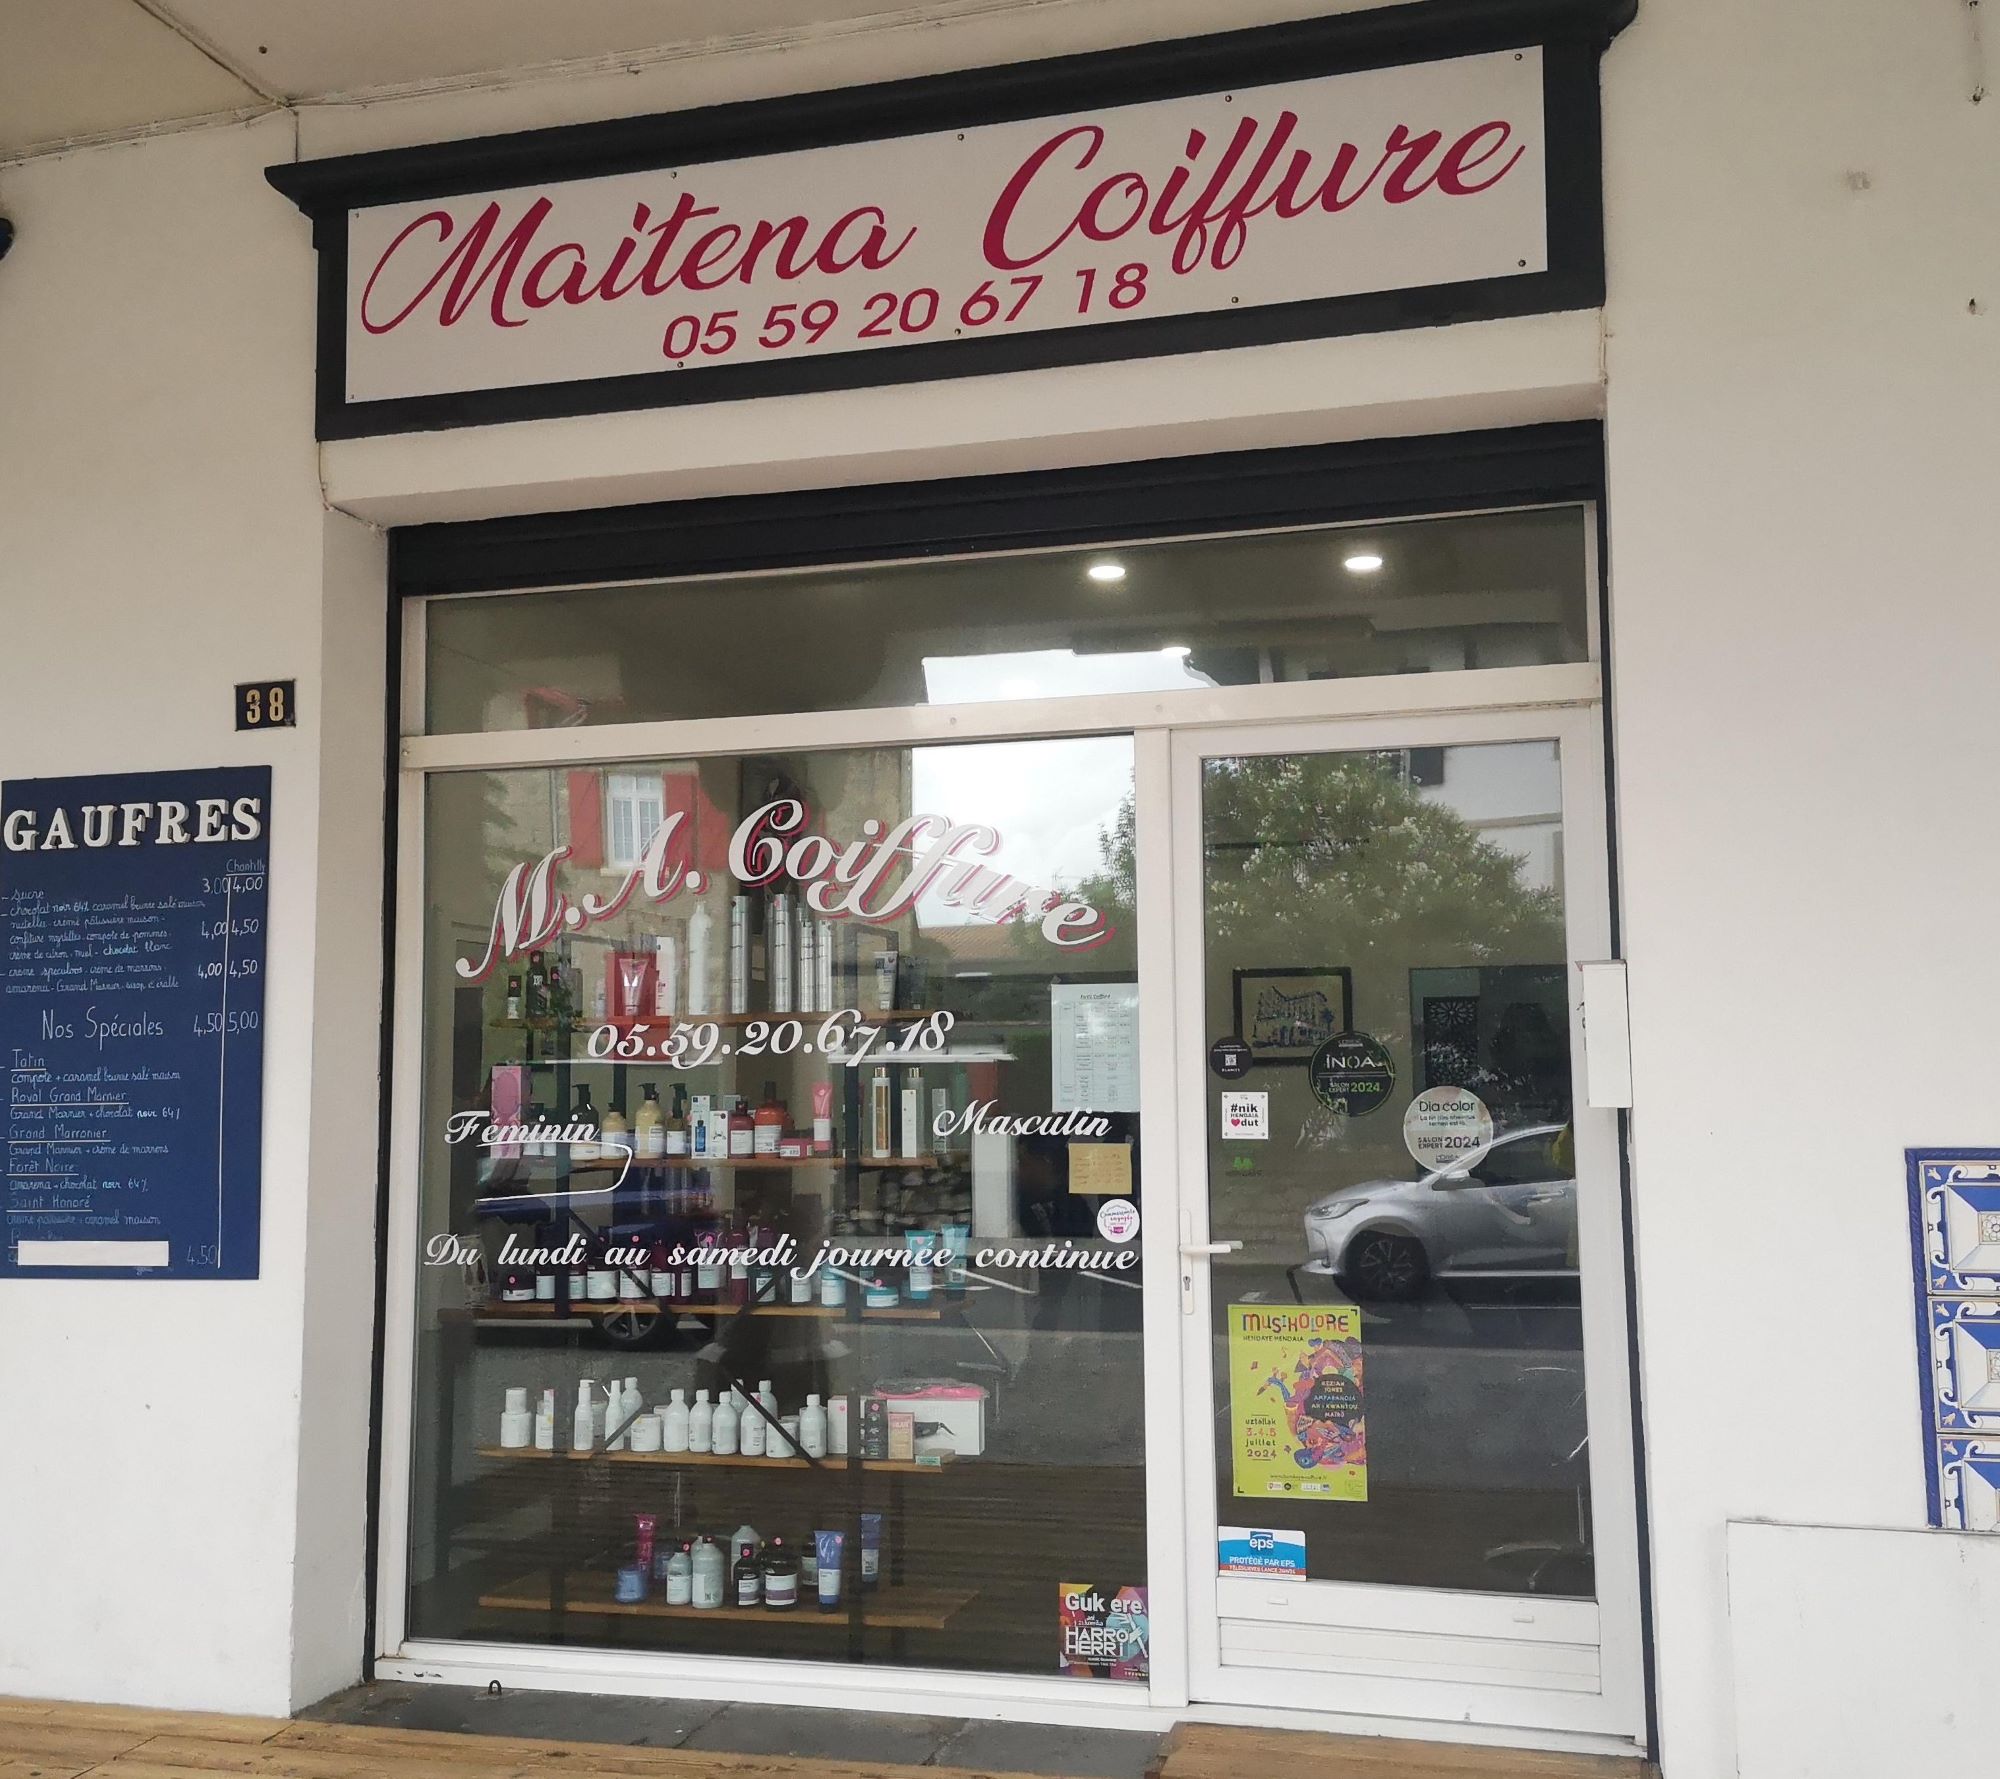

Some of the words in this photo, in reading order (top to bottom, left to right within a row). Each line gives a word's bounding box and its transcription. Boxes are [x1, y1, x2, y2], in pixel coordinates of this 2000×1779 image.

[361, 192, 917, 334] Maitena
[983, 111, 1526, 276] Coiffure
[663, 311, 738, 359] 05
[758, 299, 839, 349] 59
[857, 288, 940, 338] 20
[959, 275, 1043, 327] 67
[1075, 262, 1148, 314] 18
[246, 687, 285, 723] 38
[3, 797, 263, 852] GAUFRES
[226, 859, 265, 874] Chantilly
[729, 799, 1116, 954] Coiffure
[10, 899, 51, 916] chocolat
[52, 904, 72, 913] noir
[92, 894, 129, 912] caramel
[103, 944, 138, 956] chocolat
[229, 959, 257, 978] 4,50
[42, 1009, 74, 1040] Nos
[85, 1006, 164, 1050] Spéciales
[193, 1012, 223, 1037] 4,50
[227, 1010, 259, 1035] 5,00
[587, 1009, 955, 1069] 05.59.20.67.18
[12, 1049, 45, 1068] Tatin
[11, 1071, 52, 1089] compote
[63, 1067, 101, 1082] caramel
[50, 1086, 81, 1102] Grand
[1350, 1082, 1380, 1093] 2024
[1230, 1103, 1258, 1113] #nik
[1419, 1101, 1440, 1112] Dia
[1442, 1100, 1475, 1112] color
[933, 1099, 1112, 1138] Masculin
[1241, 1119, 1259, 1127] dut
[9, 1125, 45, 1139] Grand
[55, 1124, 107, 1139] Marronier
[1444, 1136, 1480, 1149] 2024
[9, 1158, 40, 1173] Forêt
[45, 1158, 75, 1173] Noire
[53, 1195, 91, 1208] Honoré
[424, 1233, 482, 1267] Du
[498, 1233, 587, 1266] lundi
[604, 1247, 652, 1266] au
[667, 1233, 797, 1266] samedi
[975, 1240, 1139, 1270] continue
[1245, 1438, 1276, 1448] juillet
[1247, 1449, 1277, 1459] 2024
[1249, 1538, 1274, 1551] eps
[1229, 1555, 1264, 1565] PROTÉGÉ
[1264, 1558, 1280, 1567] PAR
[1281, 1559, 1296, 1568] EPS
[1065, 1591, 1106, 1612] Guk
[1110, 1598, 1143, 1615] ere
[1065, 1626, 1128, 1643] HARRO
[1065, 1640, 1124, 1657] HERRI
